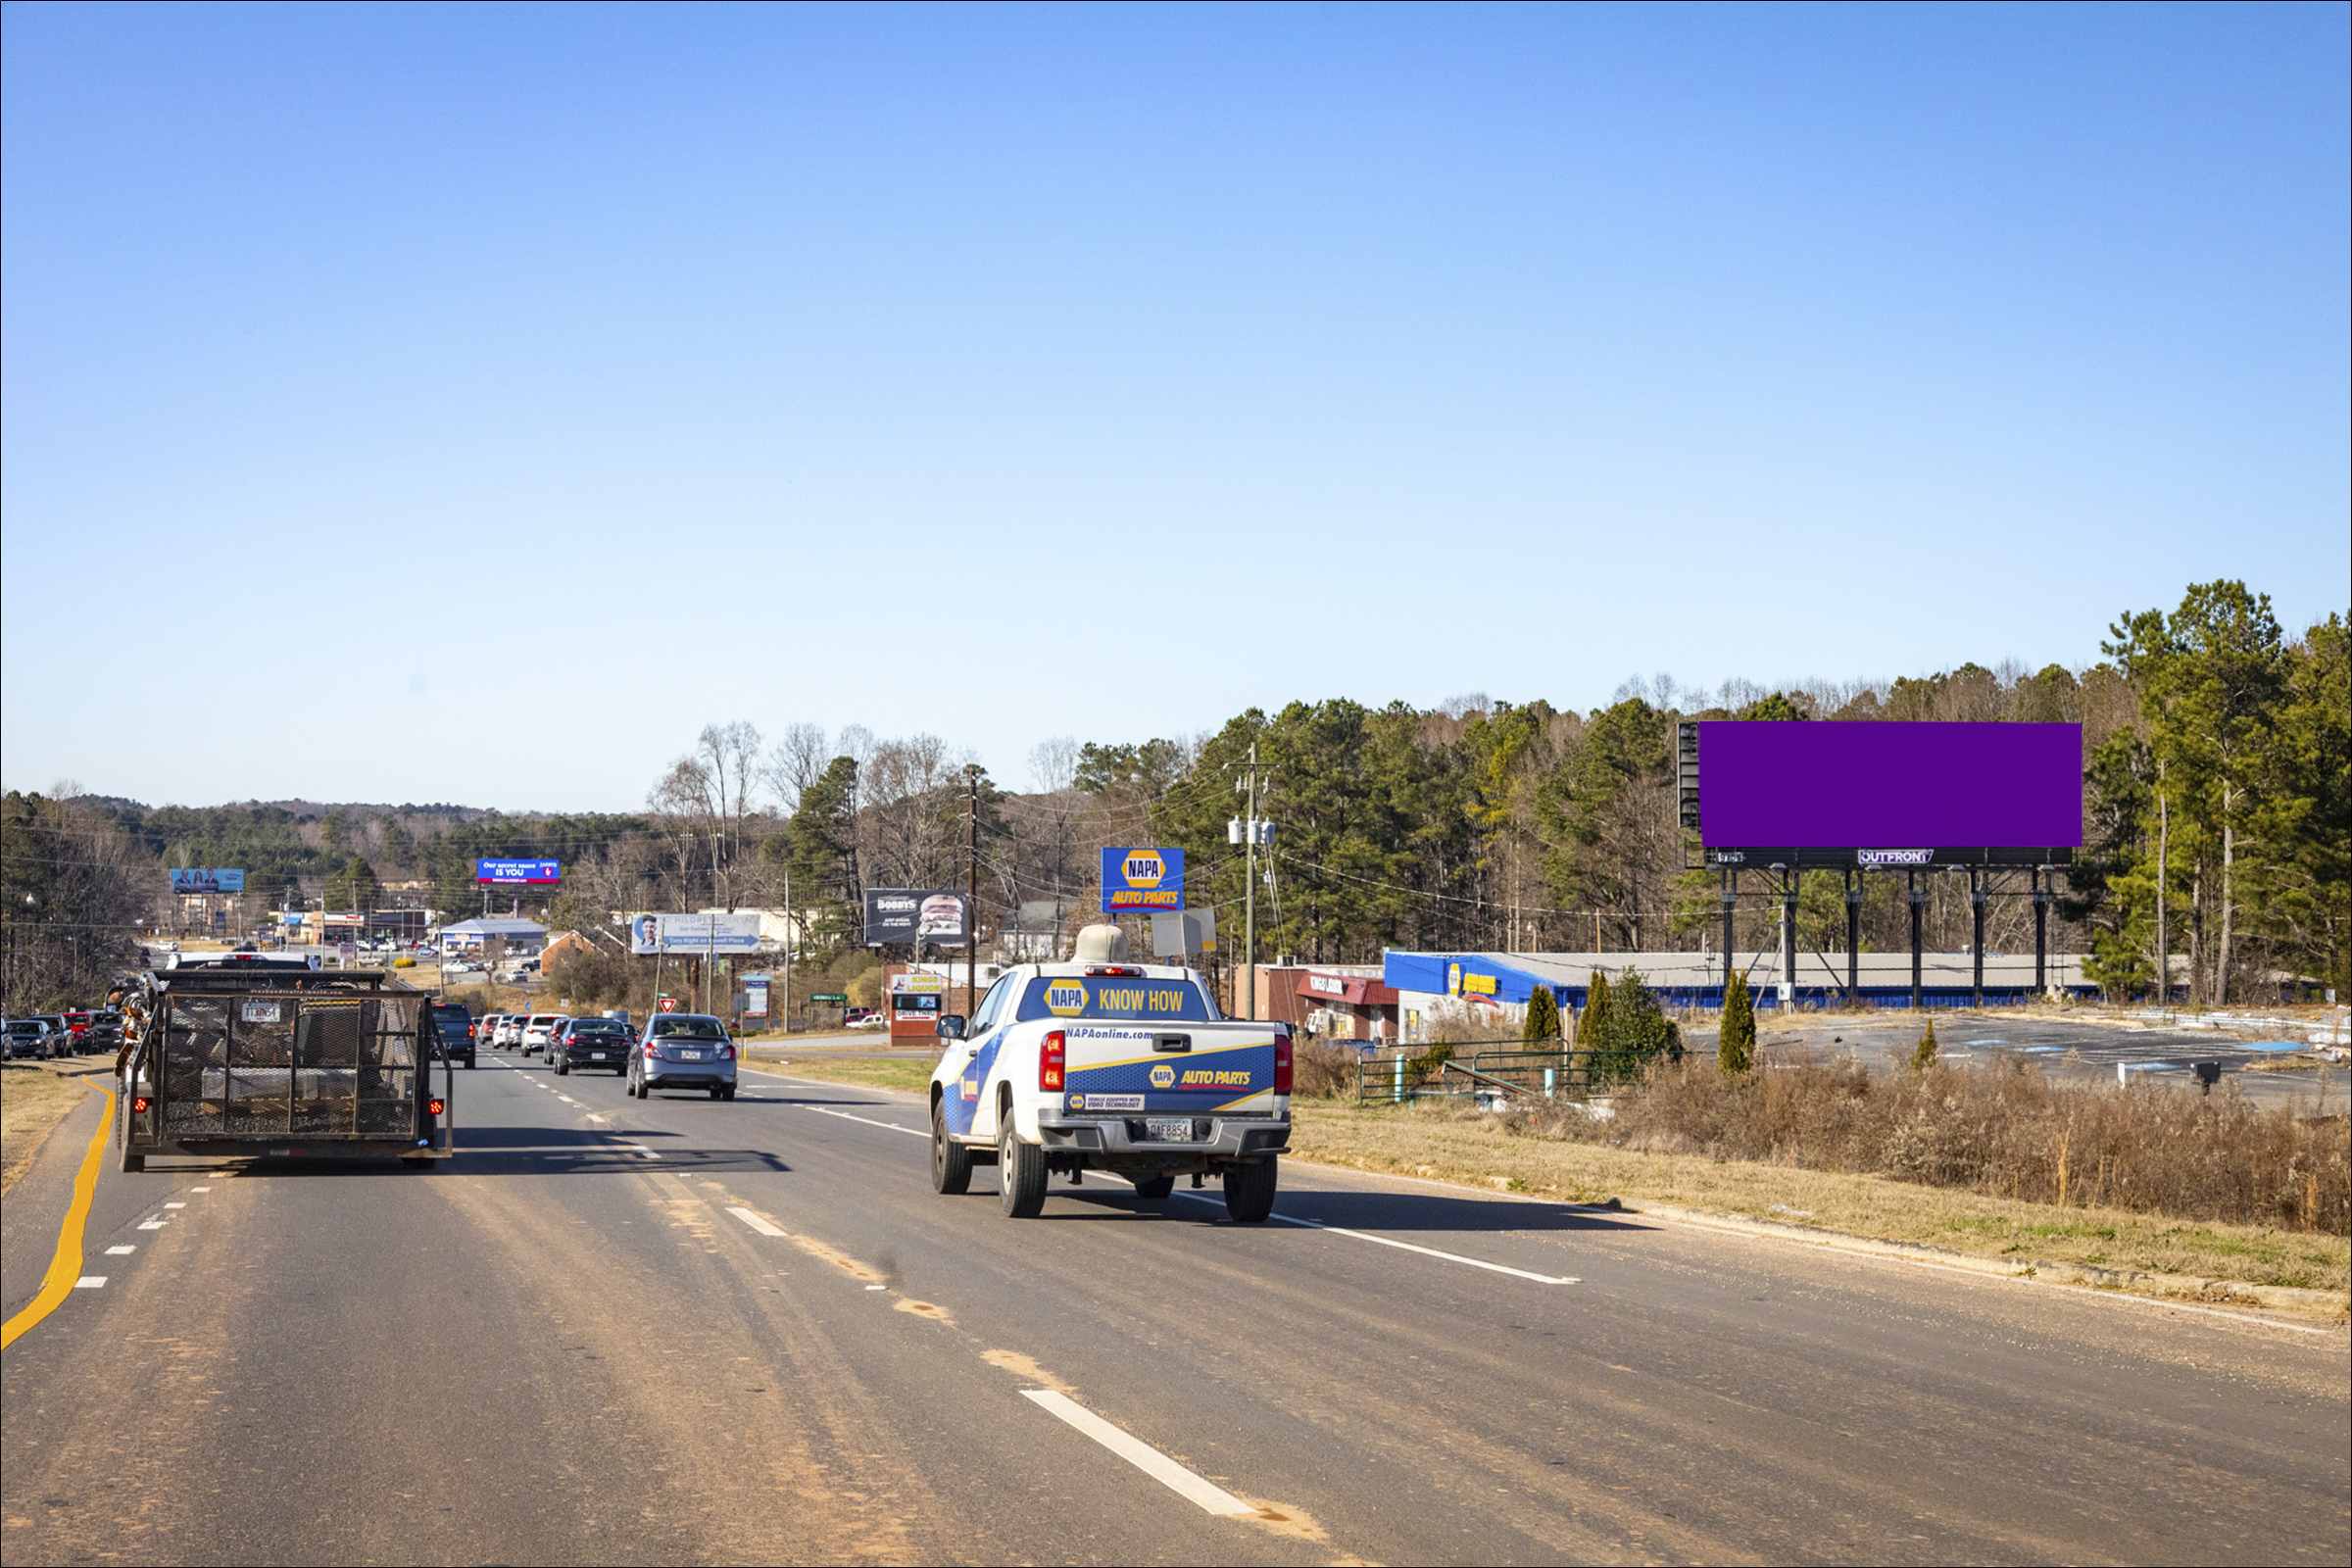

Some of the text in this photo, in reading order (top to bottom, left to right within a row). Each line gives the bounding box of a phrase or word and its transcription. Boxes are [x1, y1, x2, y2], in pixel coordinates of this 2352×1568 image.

[1861, 850, 1930, 862] OUTFRONT
[505, 868, 524, 877] YOU
[1128, 859, 1158, 878] NAPA
[1111, 891, 1179, 904] AUTO PARTS
[1051, 989, 1184, 1012] NAPA KNOW HOW
[1066, 1028, 1153, 1040] NAPAonline.com
[1152, 1070, 1251, 1086] NAPA AUTO PARTS
